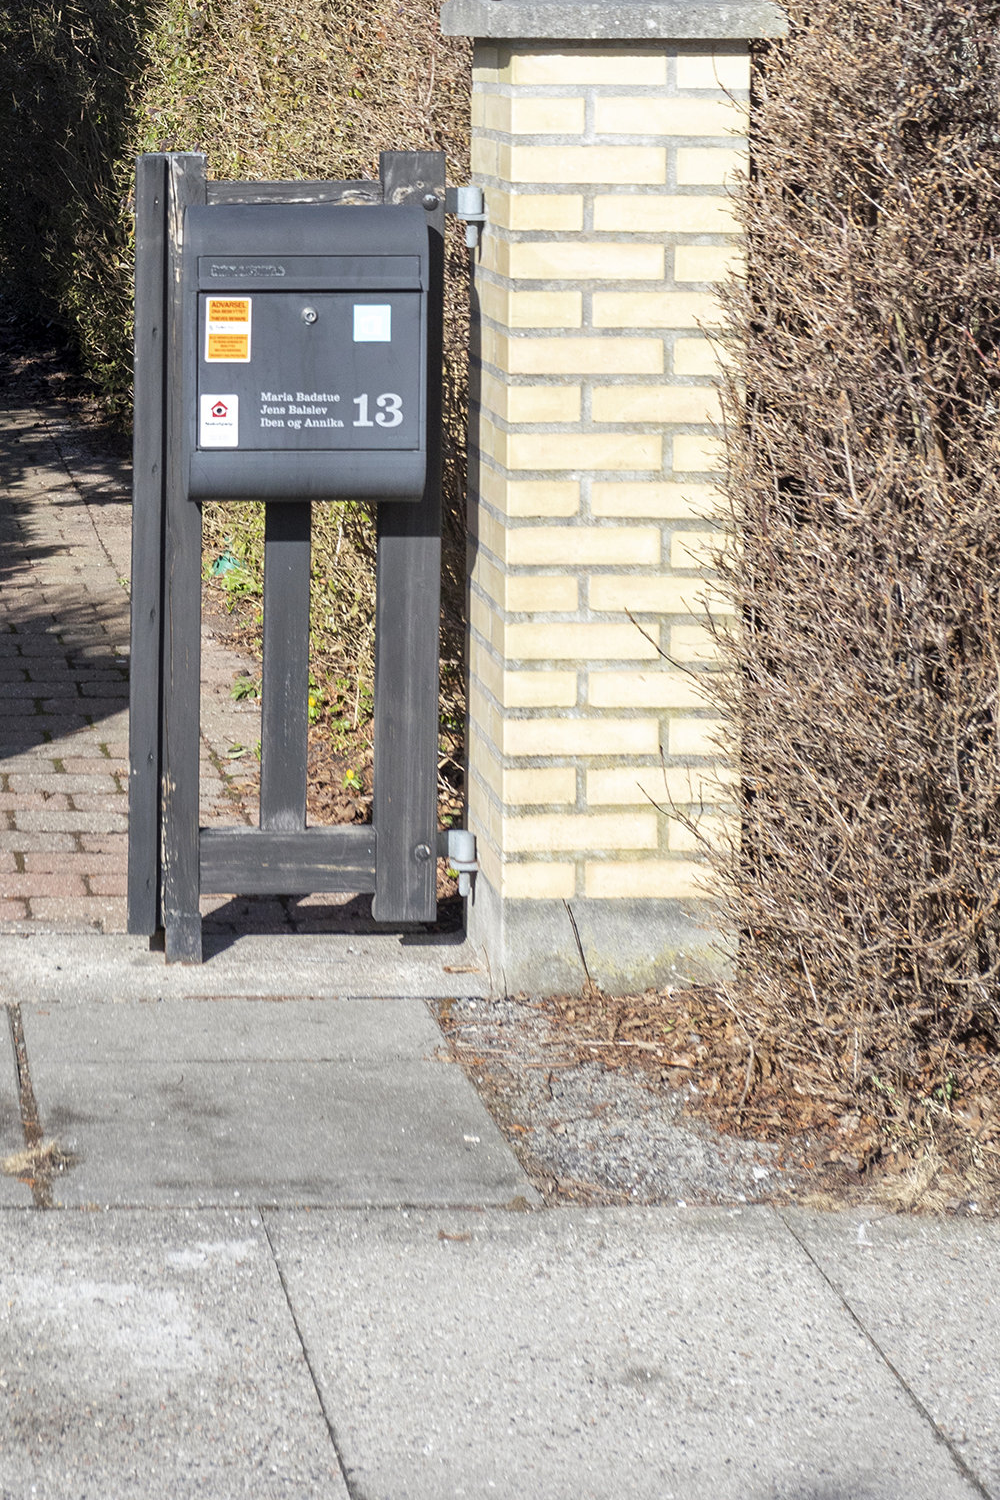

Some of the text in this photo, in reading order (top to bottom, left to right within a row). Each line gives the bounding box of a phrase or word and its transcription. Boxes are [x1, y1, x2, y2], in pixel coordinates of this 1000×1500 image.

[260, 391, 340, 402] Maria Badstue
[260, 404, 328, 415] Jens Balslev
[352, 393, 404, 428] 13
[260, 417, 345, 430] Iben og Annika
